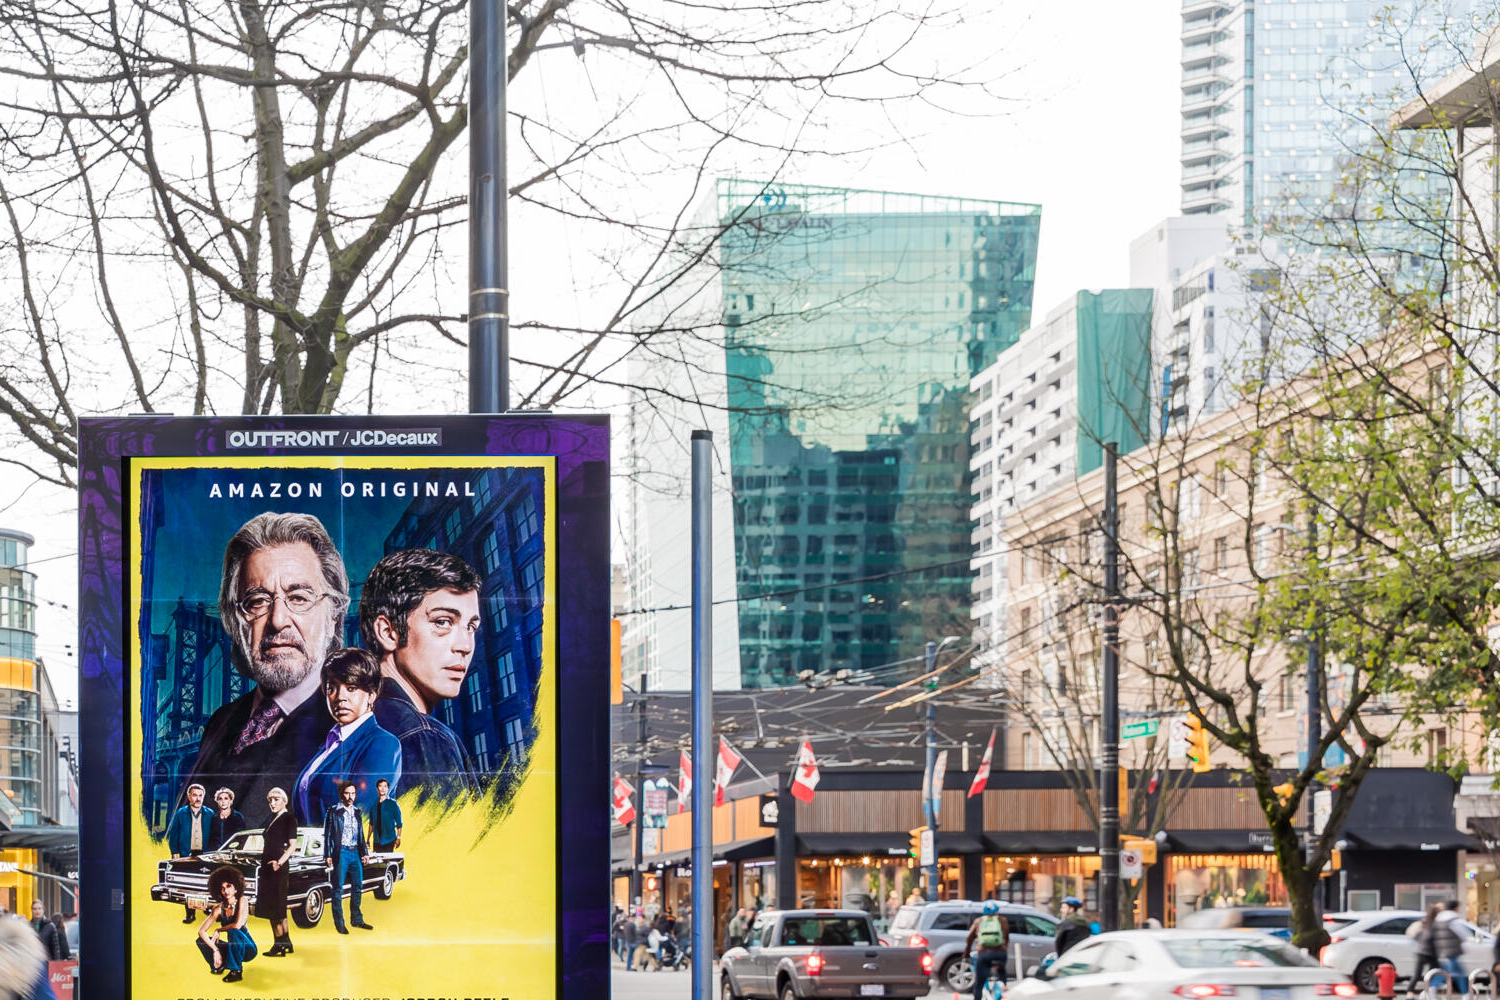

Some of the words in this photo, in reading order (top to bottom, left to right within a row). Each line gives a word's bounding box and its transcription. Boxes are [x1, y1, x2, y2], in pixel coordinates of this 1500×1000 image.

[229, 431, 340, 447] OUTFRONT
[209, 483, 323, 498] AMAZON
[340, 482, 475, 497] ORIGINAL
